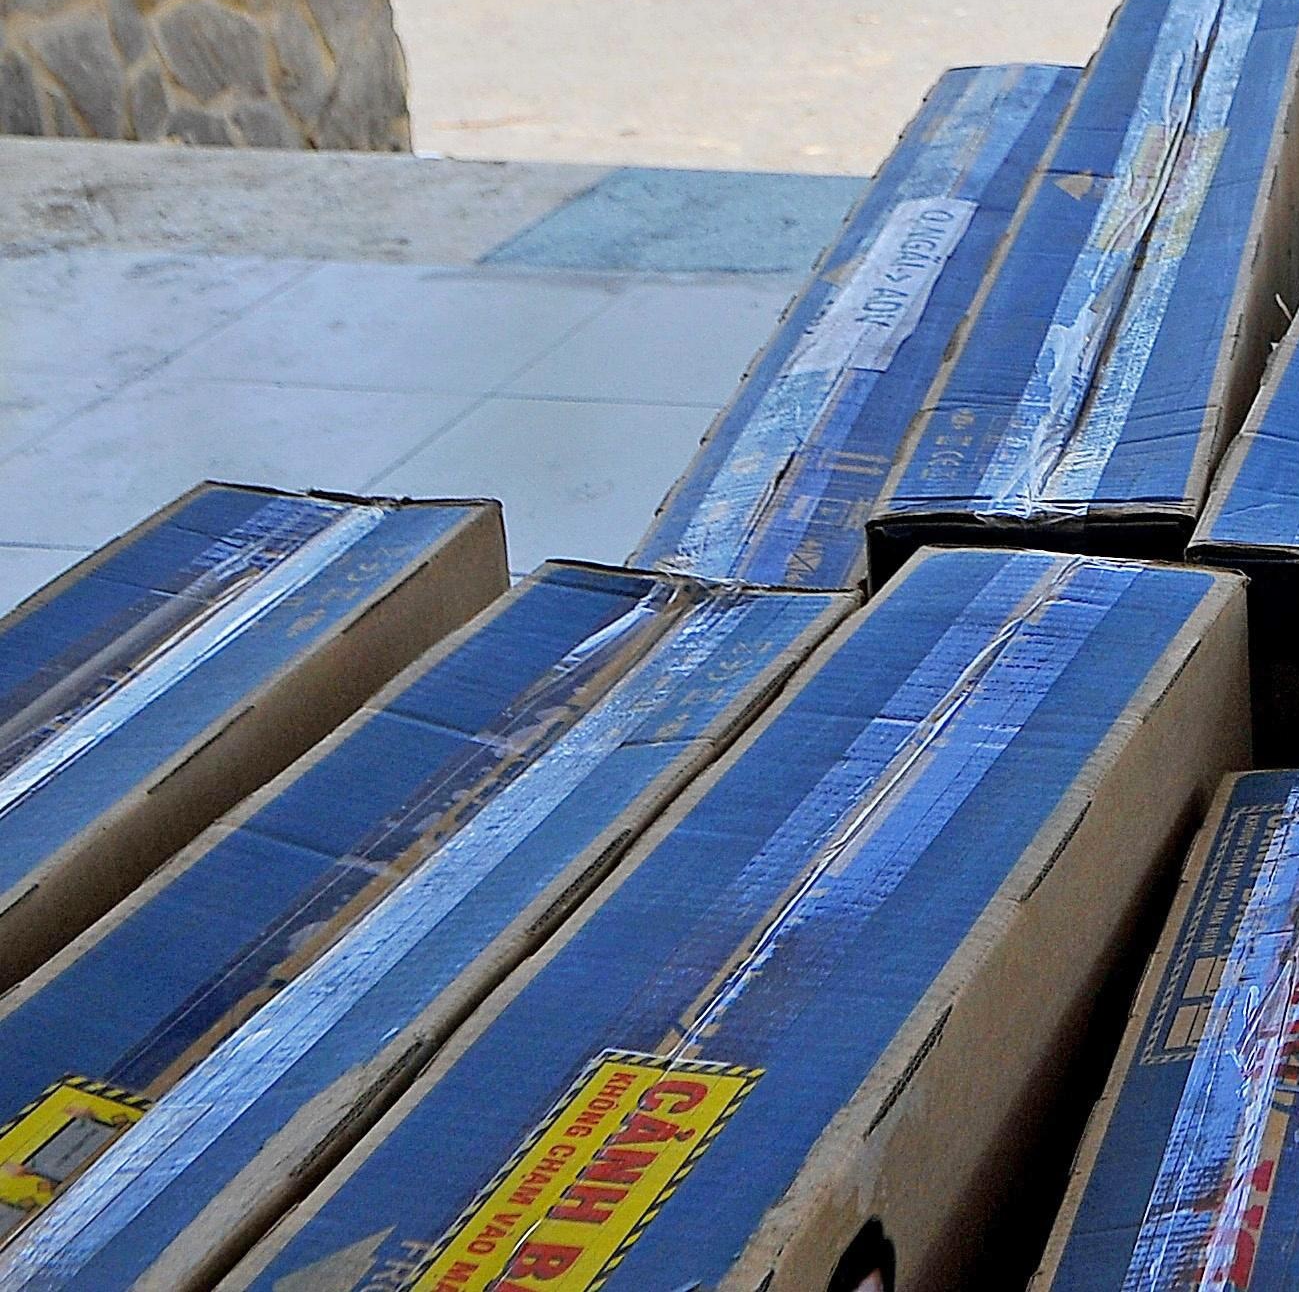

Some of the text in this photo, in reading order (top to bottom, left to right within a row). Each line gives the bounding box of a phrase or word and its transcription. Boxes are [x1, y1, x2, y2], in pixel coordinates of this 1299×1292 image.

[565, 1072, 639, 1139] KHÔNG
[508, 1143, 577, 1206] CHẠM
[551, 1079, 710, 1225] CẢNH
[467, 1212, 523, 1256] VÀO
